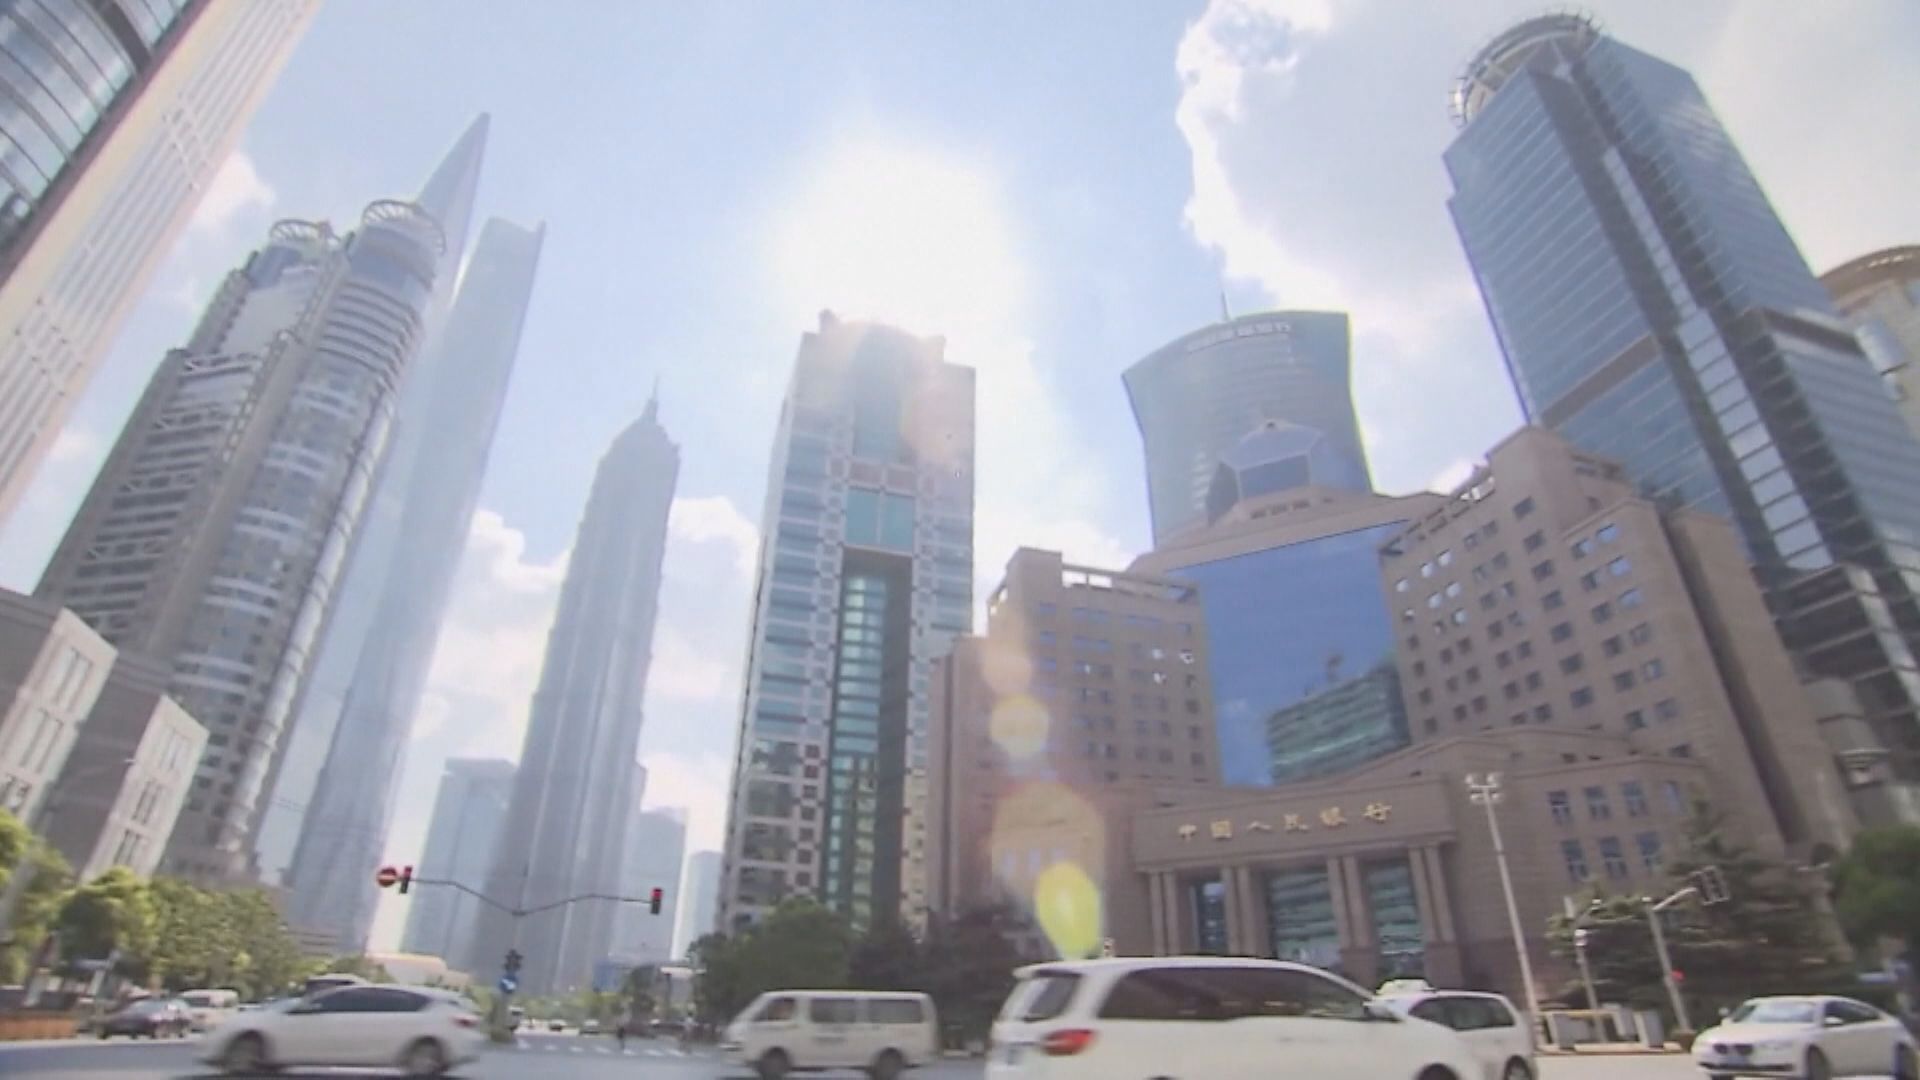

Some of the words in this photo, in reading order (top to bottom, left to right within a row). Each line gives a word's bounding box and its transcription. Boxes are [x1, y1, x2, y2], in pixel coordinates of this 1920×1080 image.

[1177, 802, 1393, 842] 中国人民银行
